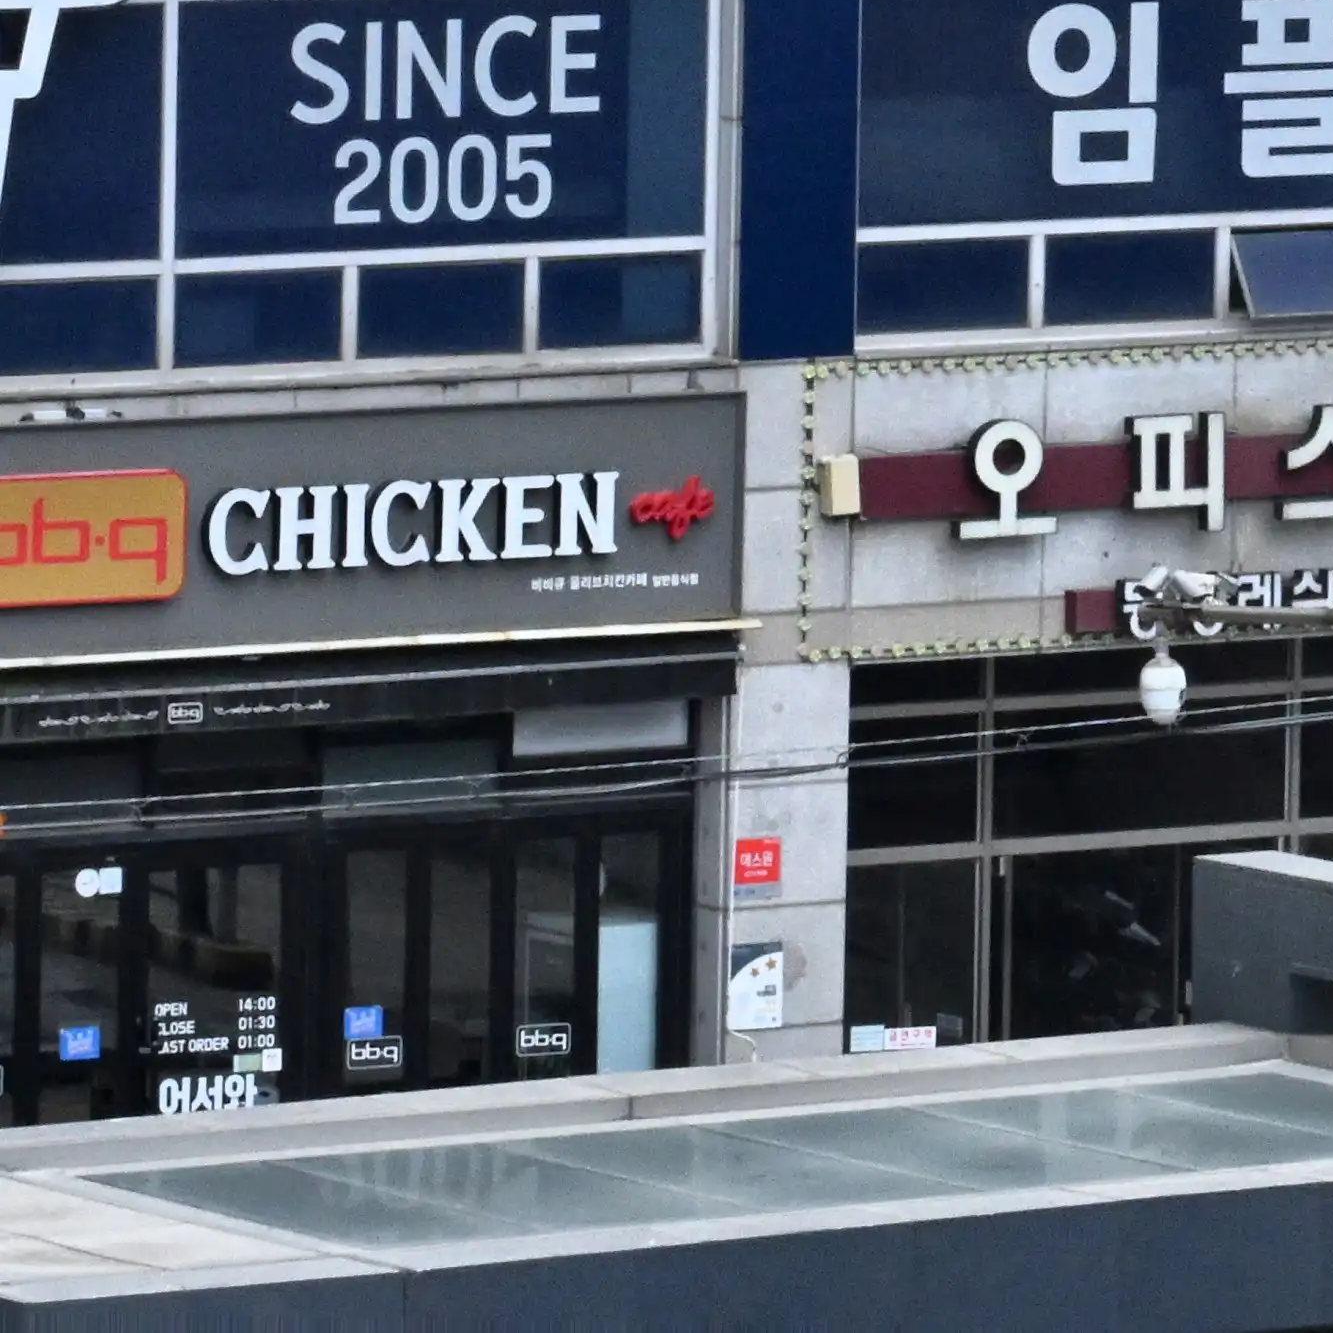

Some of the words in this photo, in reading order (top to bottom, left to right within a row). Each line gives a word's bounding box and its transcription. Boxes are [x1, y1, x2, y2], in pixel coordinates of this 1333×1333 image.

[290, 12, 603, 126] SINCE
[333, 132, 555, 227] 2005
[207, 471, 620, 578] CHICKEN
[154, 1001, 189, 1018] OPEN
[238, 995, 277, 1012] 14:00
[237, 1014, 277, 1031] 01:30
[187, 1036, 230, 1053] ORDER
[237, 1033, 276, 1050] 01:00
[158, 1072, 259, 1116] 어서와
